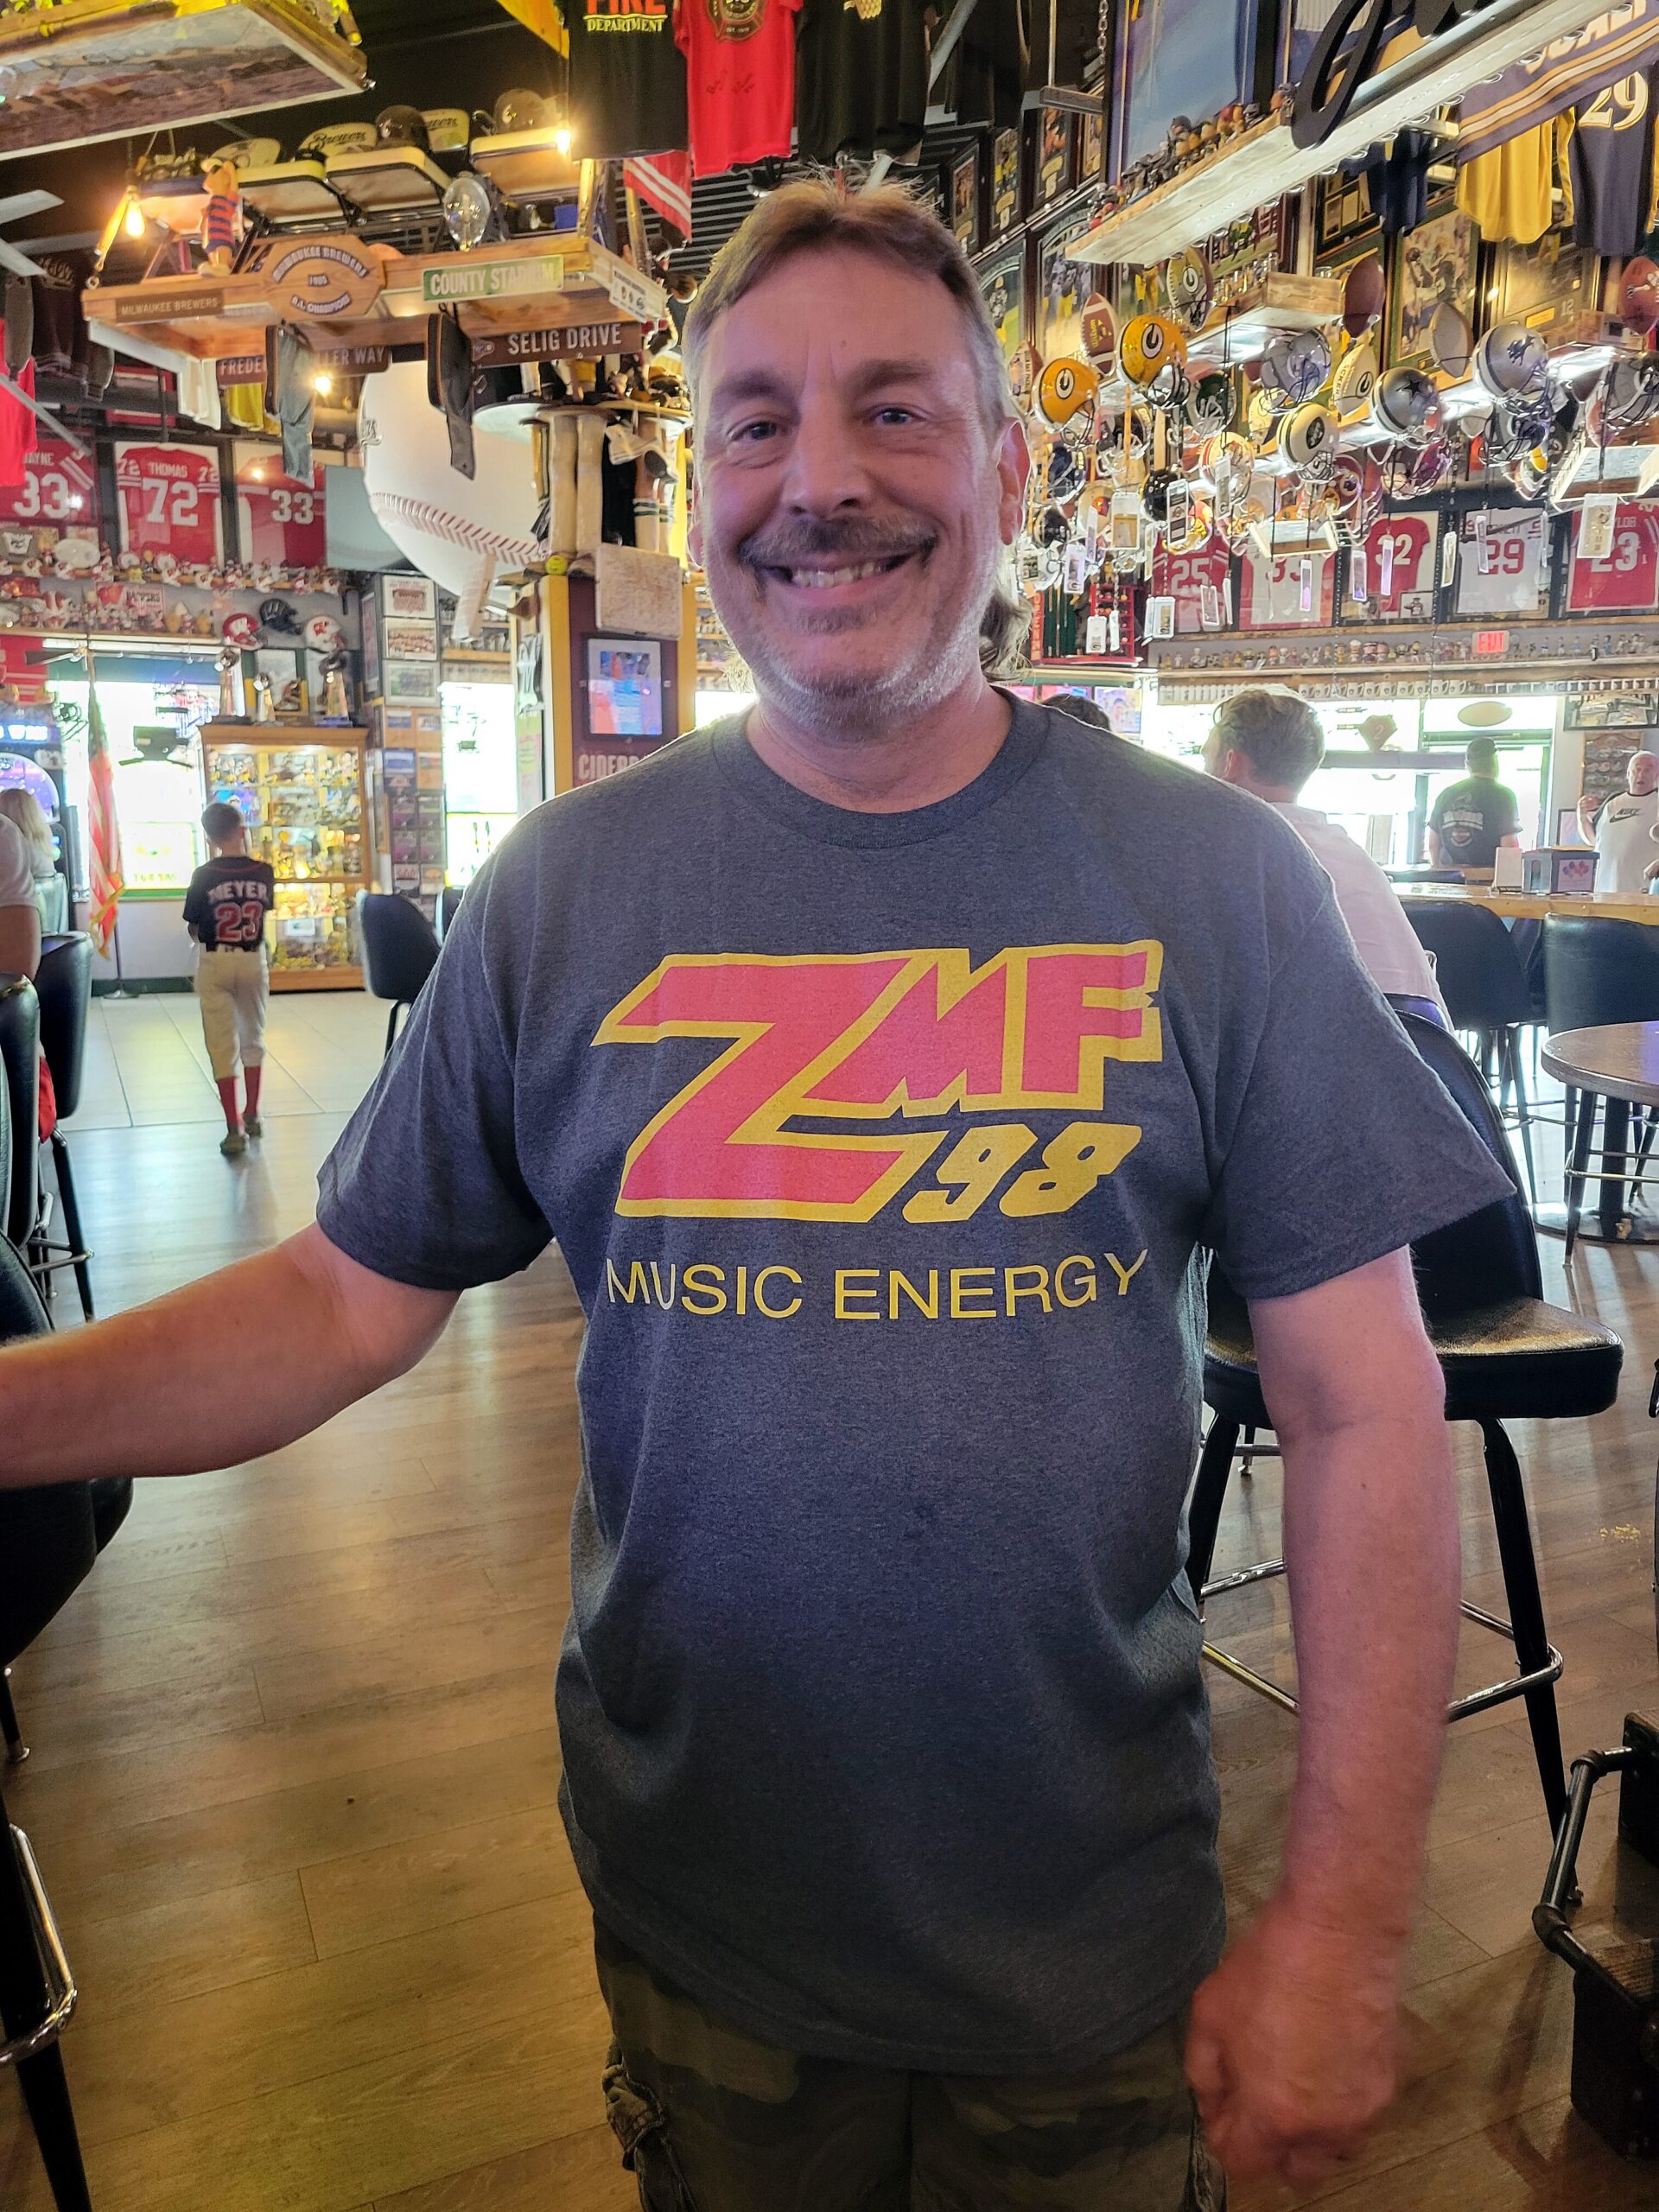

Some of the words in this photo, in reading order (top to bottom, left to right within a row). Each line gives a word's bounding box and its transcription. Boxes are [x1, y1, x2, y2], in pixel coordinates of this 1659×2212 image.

[587, 18, 664, 32] DEPARTMENT
[1579, 72, 1648, 130] 29
[309, 130, 367, 149] Brewers
[430, 269, 486, 296] COUNTY
[490, 262, 556, 291] STADIUM
[121, 302, 172, 316] MILWAUKEE
[174, 296, 220, 312] BREWERS
[508, 328, 561, 355] SELIG
[566, 323, 622, 350] DRIVE
[220, 356, 266, 375] FREDE
[355, 346, 385, 365] WAY
[149, 461, 188, 478] THOMAS
[13, 471, 70, 518] 33
[142, 478, 199, 526] 72
[271, 489, 315, 525] 33
[1171, 557, 1211, 596] 25
[1478, 632, 1505, 654] EXIT
[207, 880, 270, 906] MEYER
[214, 900, 264, 943] 23
[591, 939, 1164, 1224] ZMF
[903, 1121, 1142, 1224] 98
[605, 1258, 803, 1318] MUSIC
[834, 1248, 1148, 1319] ENERGY
